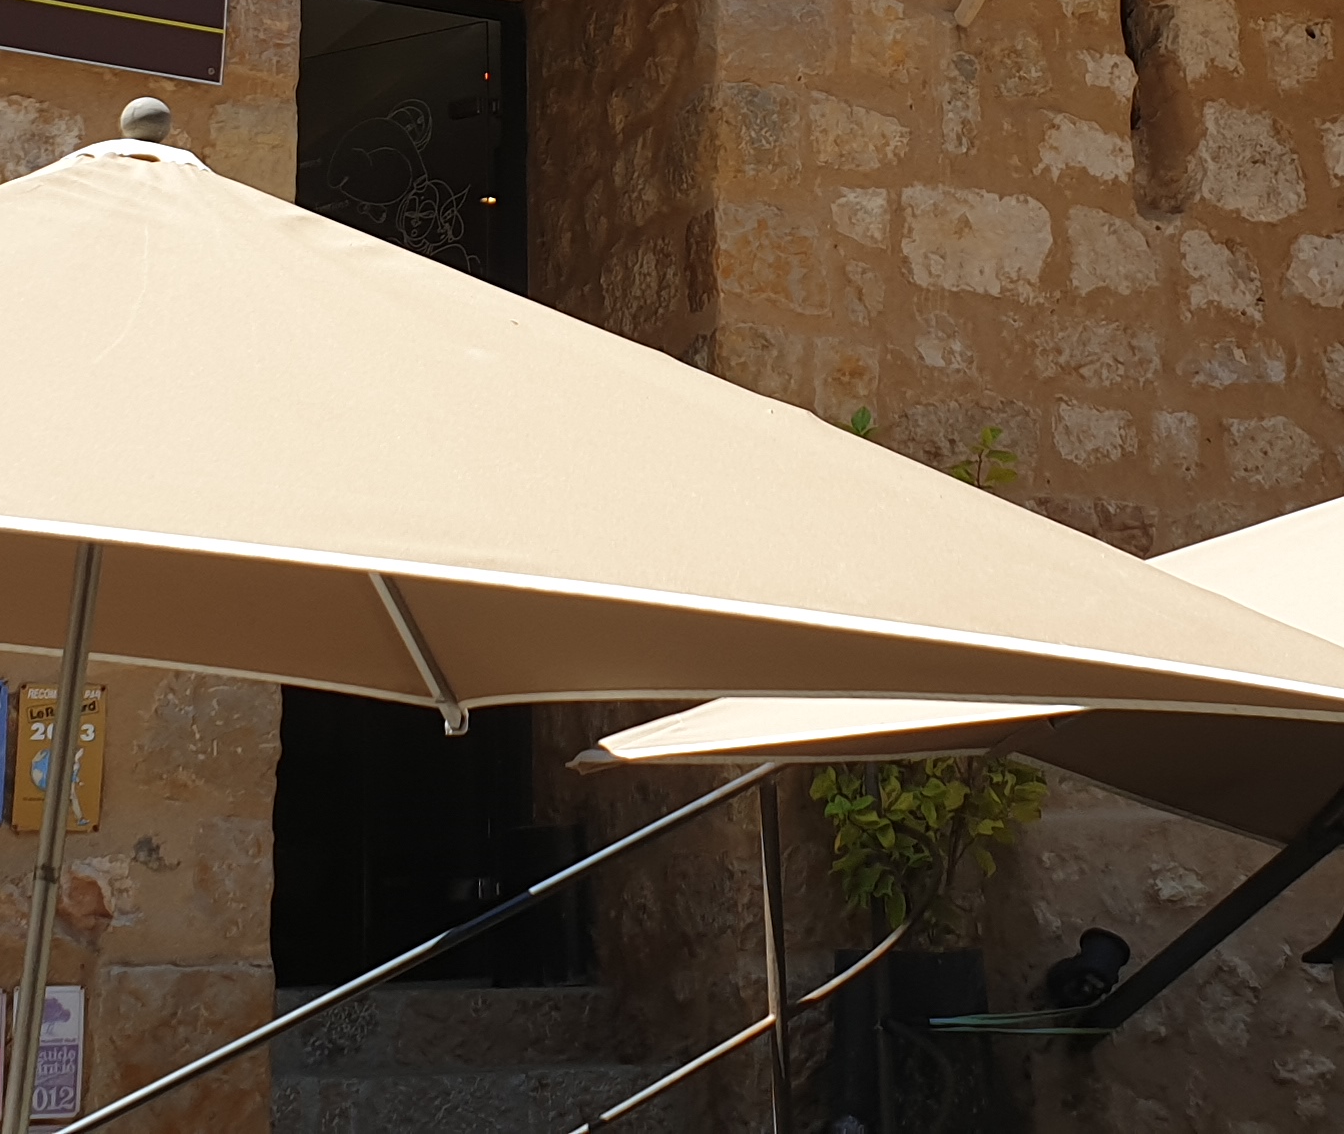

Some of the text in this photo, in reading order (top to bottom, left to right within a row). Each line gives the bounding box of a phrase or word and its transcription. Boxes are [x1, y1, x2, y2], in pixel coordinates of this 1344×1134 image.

[29, 709, 45, 721] Le
[29, 722, 96, 742] 23
[32, 1086, 75, 1111] 012
